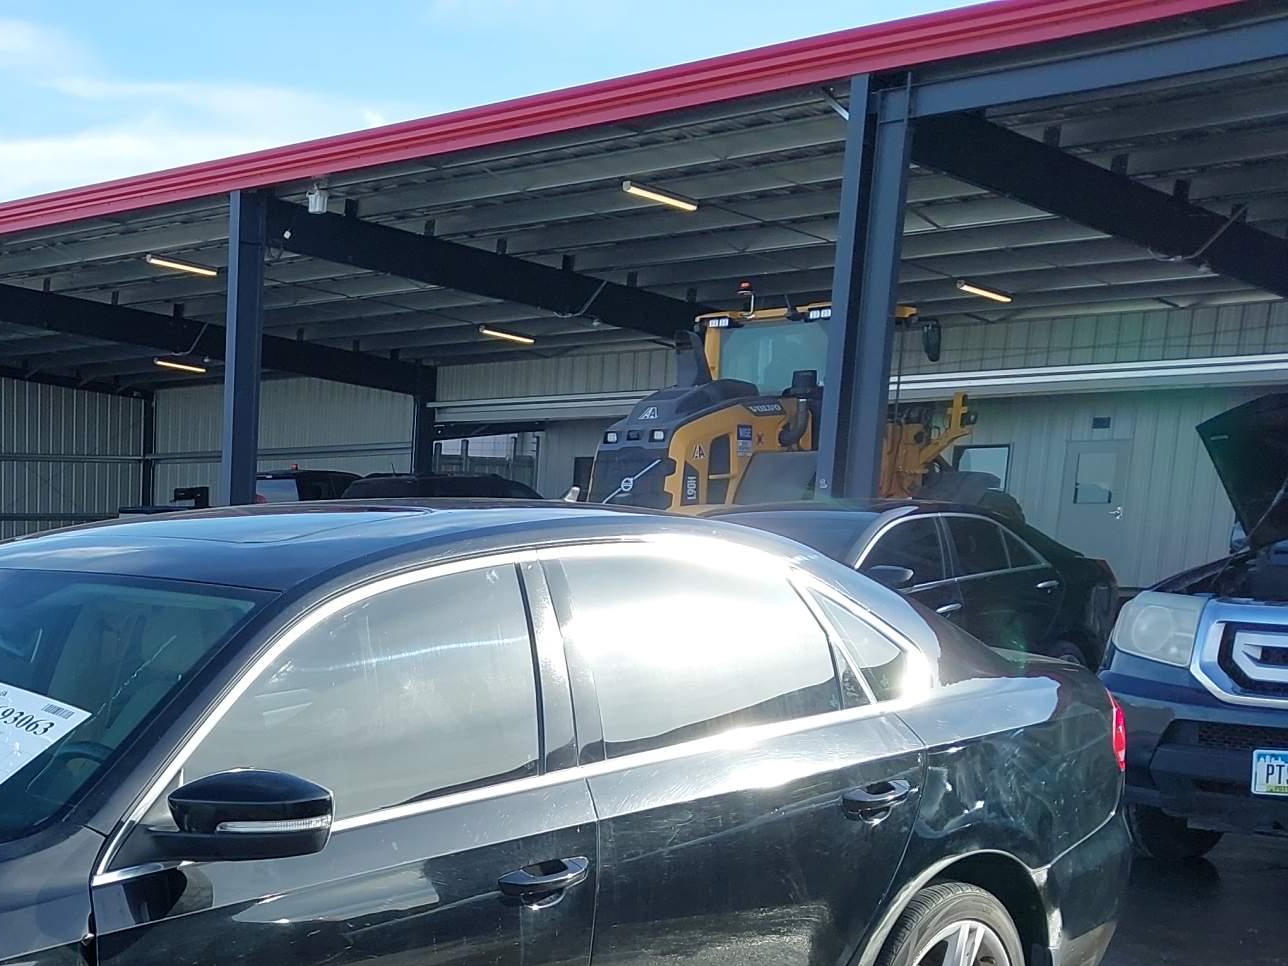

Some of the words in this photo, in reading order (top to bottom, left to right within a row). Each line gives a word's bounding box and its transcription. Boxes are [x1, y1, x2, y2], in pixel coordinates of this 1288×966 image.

[748, 404, 782, 413] VOLVO
[687, 476, 697, 499] L90H
[1265, 763, 1288, 785] PT
